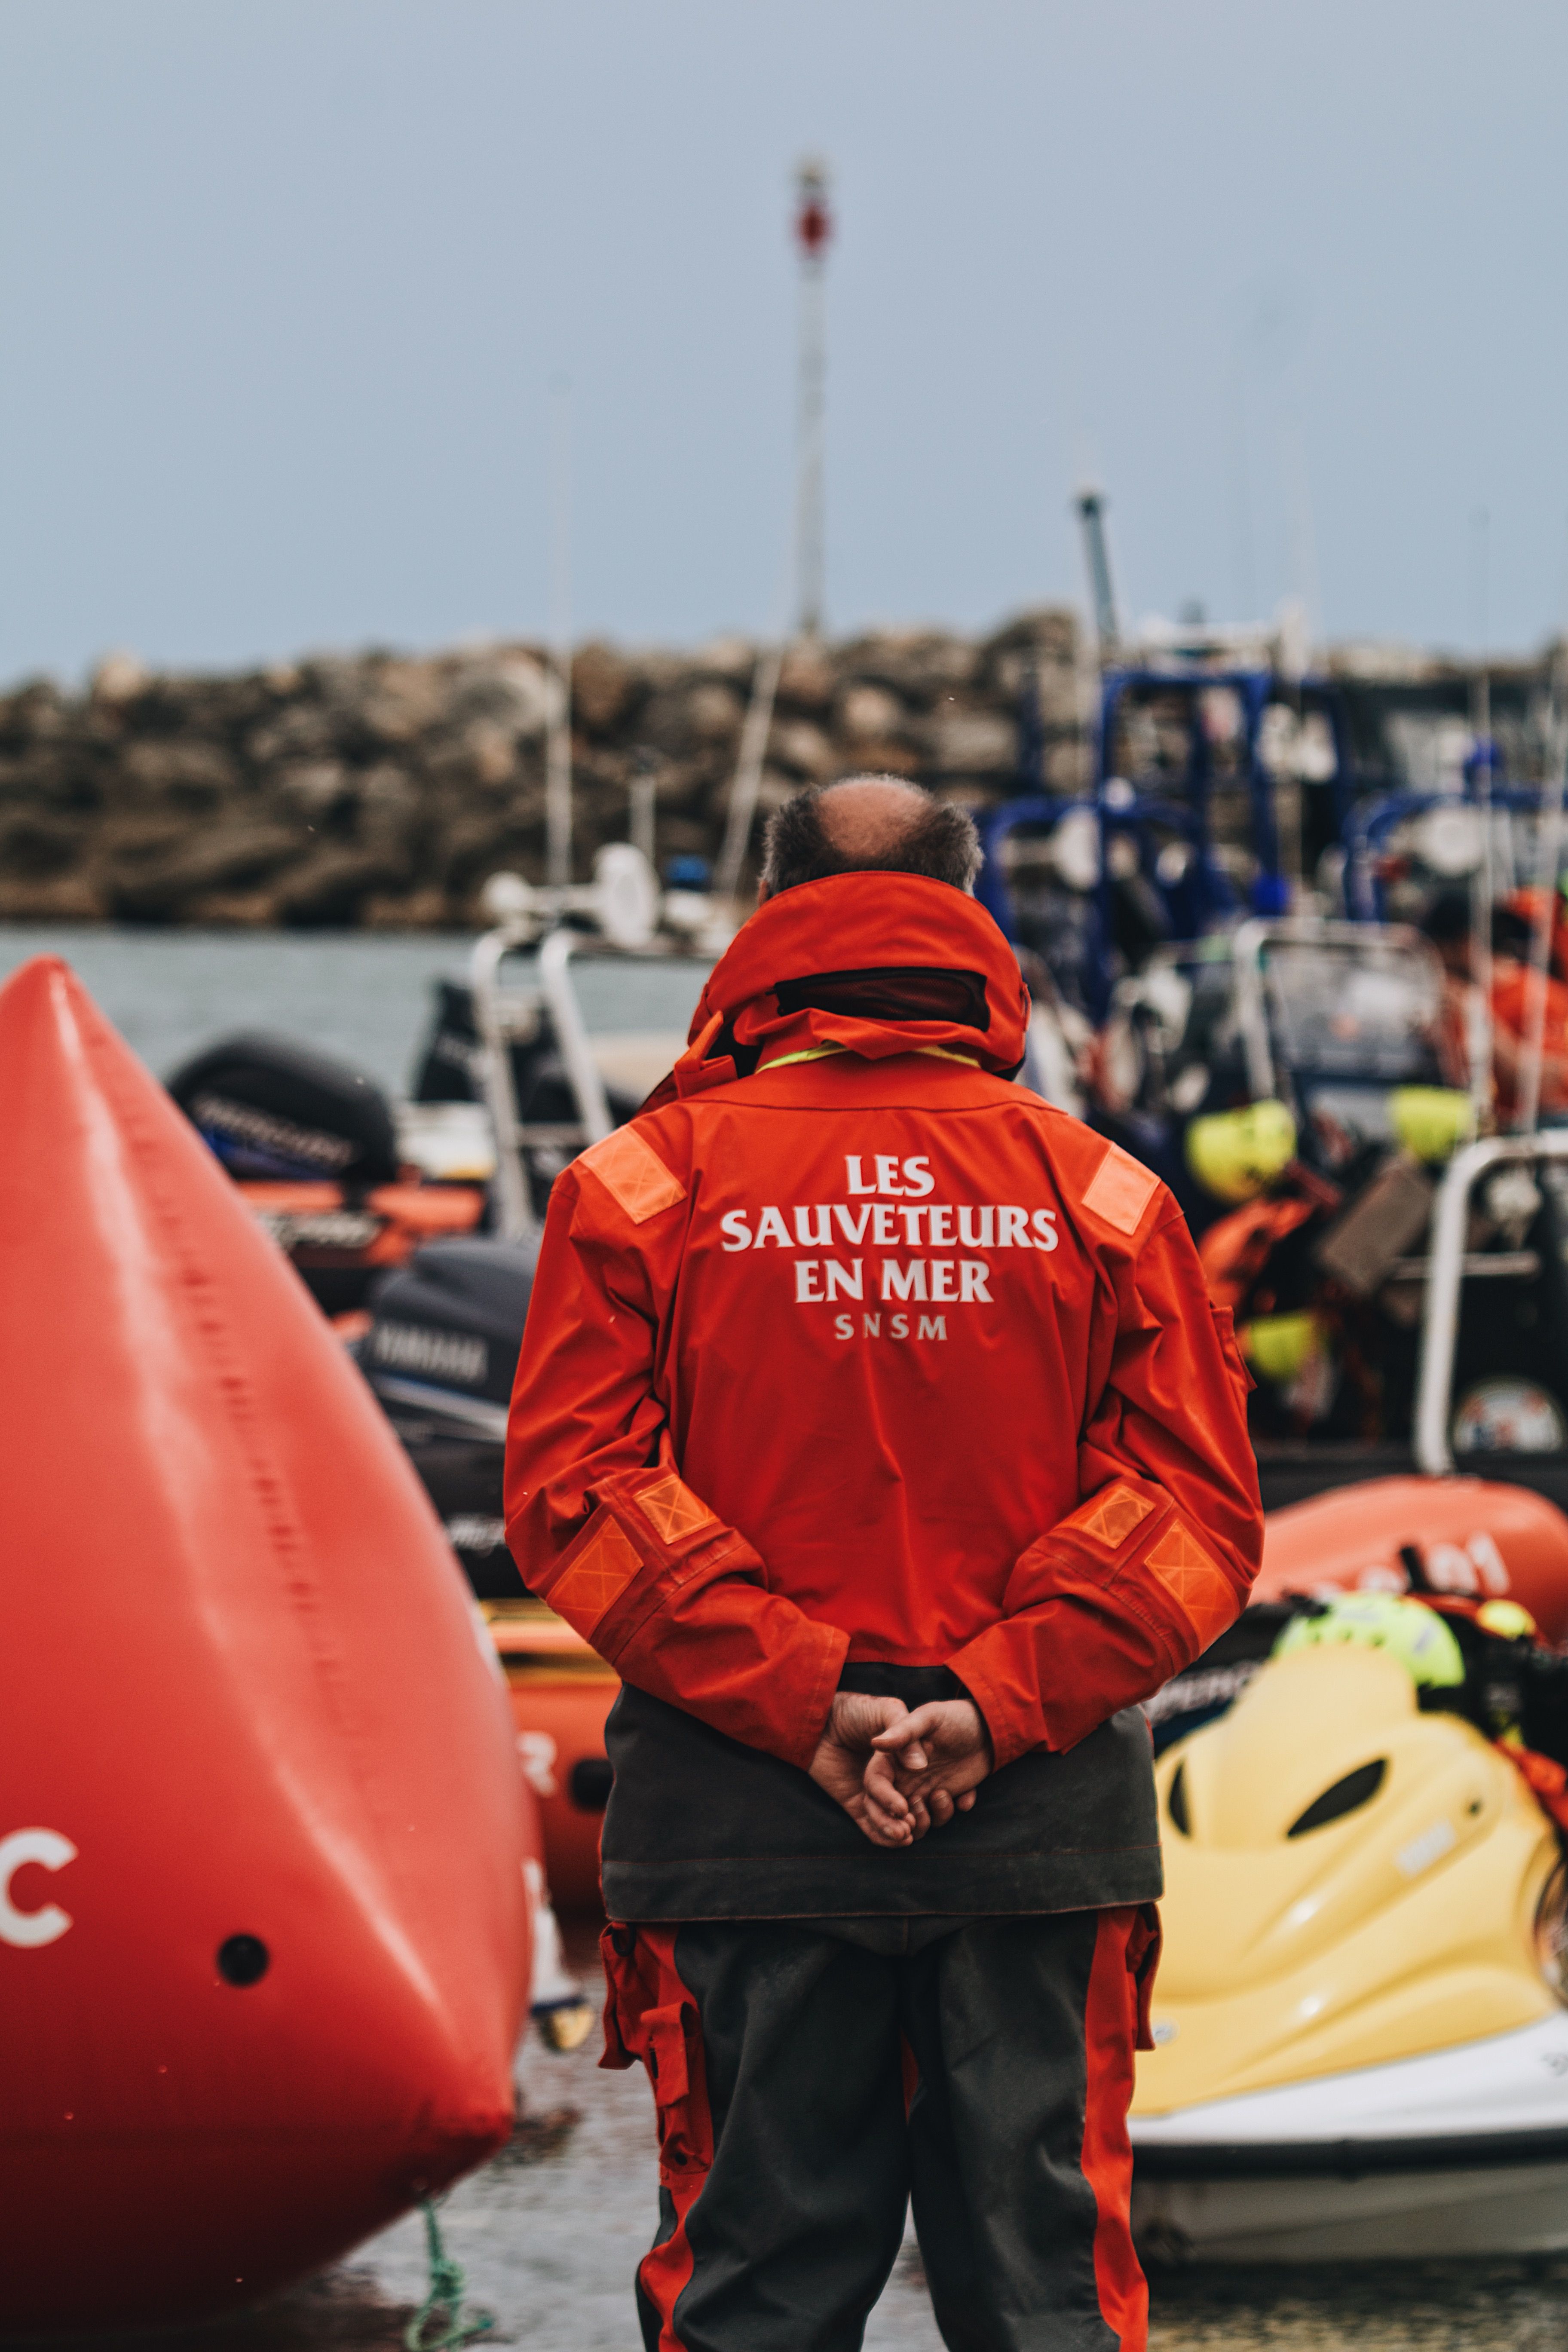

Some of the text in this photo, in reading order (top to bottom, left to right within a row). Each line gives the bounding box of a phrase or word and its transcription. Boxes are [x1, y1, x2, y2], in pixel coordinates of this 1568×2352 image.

[845, 1155, 934, 1197] LES
[721, 1204, 1058, 1251] SAUVETEURS
[795, 1259, 993, 1302] EN MER
[836, 1314, 946, 1340] SNSM
